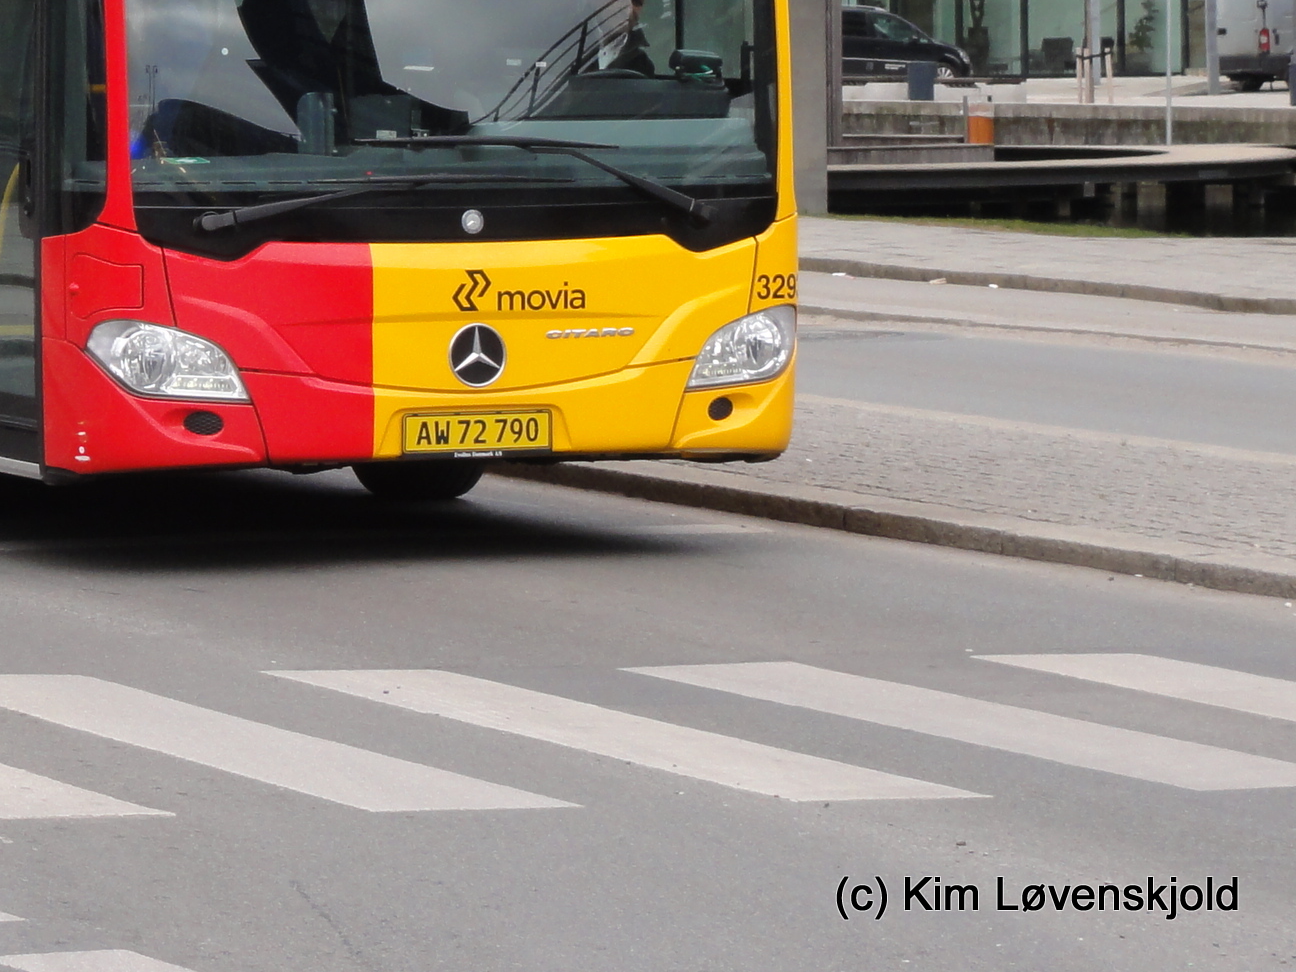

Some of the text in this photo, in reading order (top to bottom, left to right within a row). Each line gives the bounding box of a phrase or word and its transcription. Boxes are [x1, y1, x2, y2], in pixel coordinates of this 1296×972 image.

[497, 281, 587, 311] movia
[757, 273, 798, 300] 329
[546, 327, 635, 340] CITARO
[416, 417, 539, 445] AW 72 790
